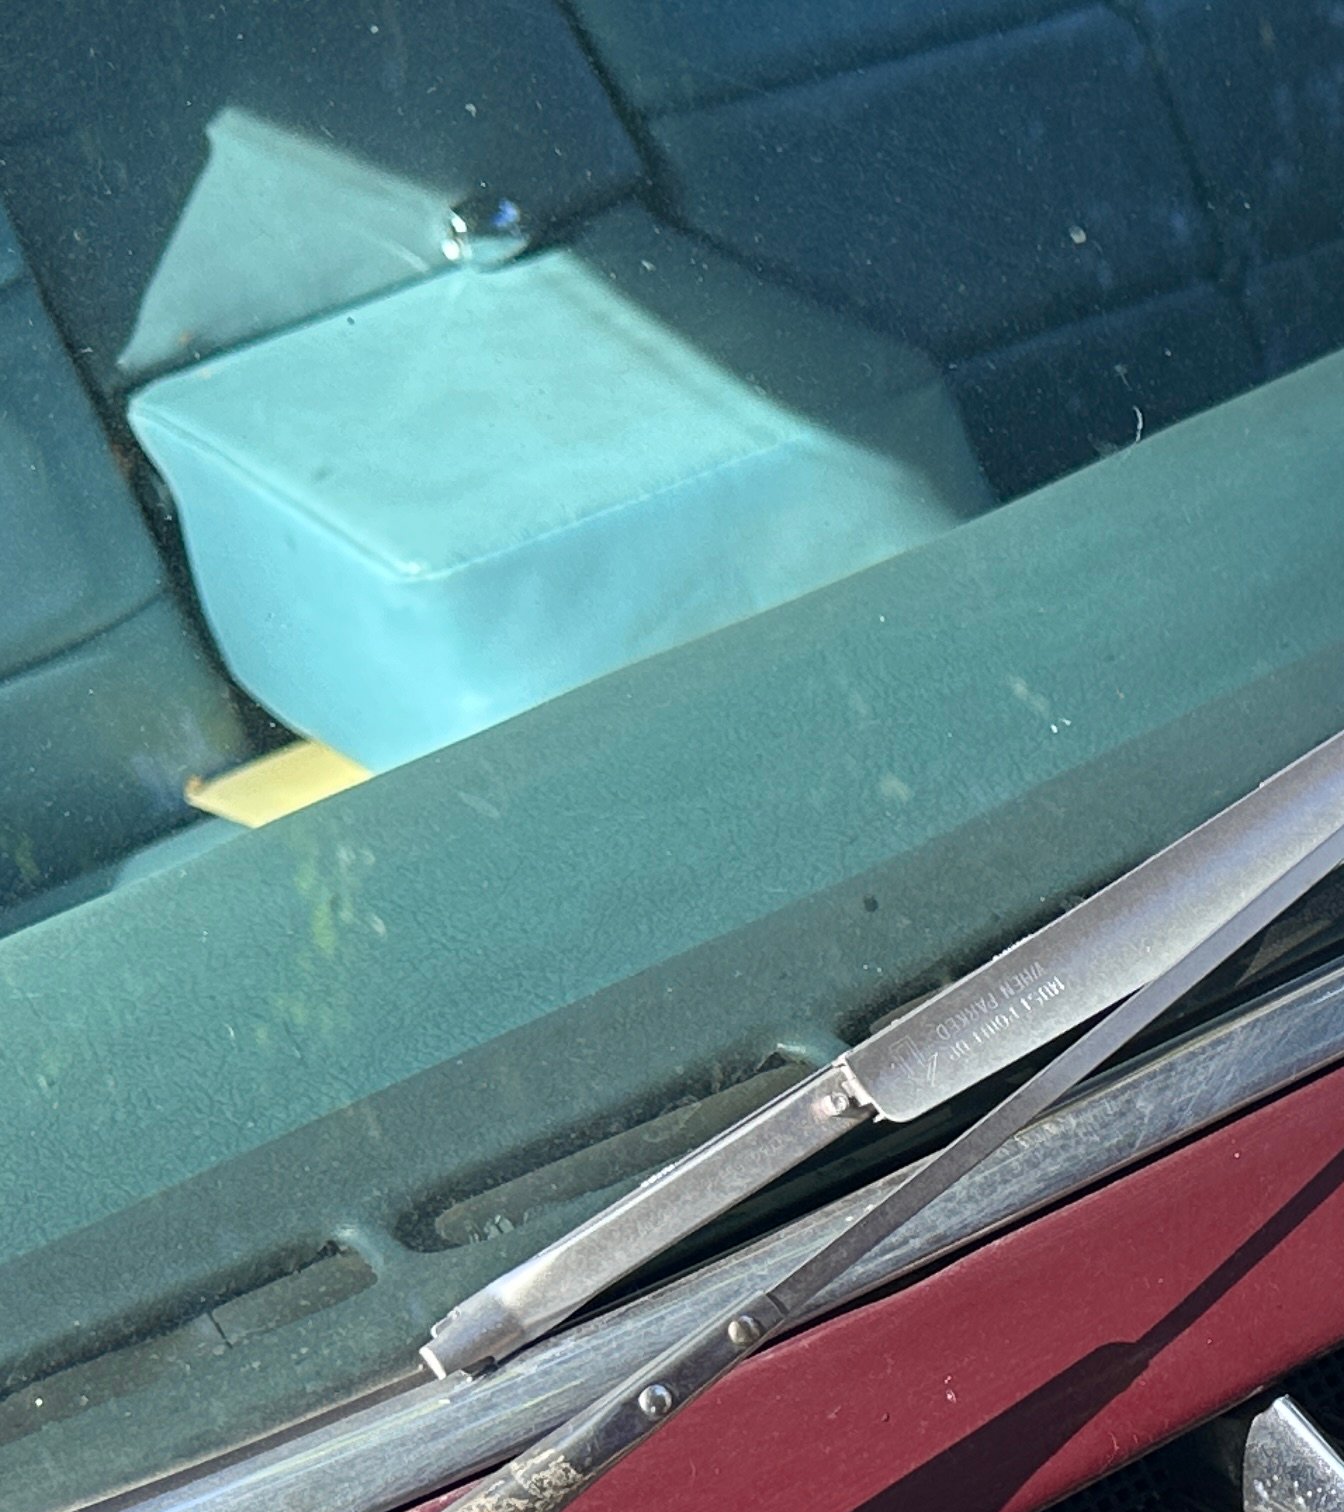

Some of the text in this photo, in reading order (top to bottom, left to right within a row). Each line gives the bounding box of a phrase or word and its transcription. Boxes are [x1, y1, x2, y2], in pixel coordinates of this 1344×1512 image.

[933, 960, 1047, 1041] WHEN PARKED
[946, 975, 1066, 1062] MUST POINT UP
